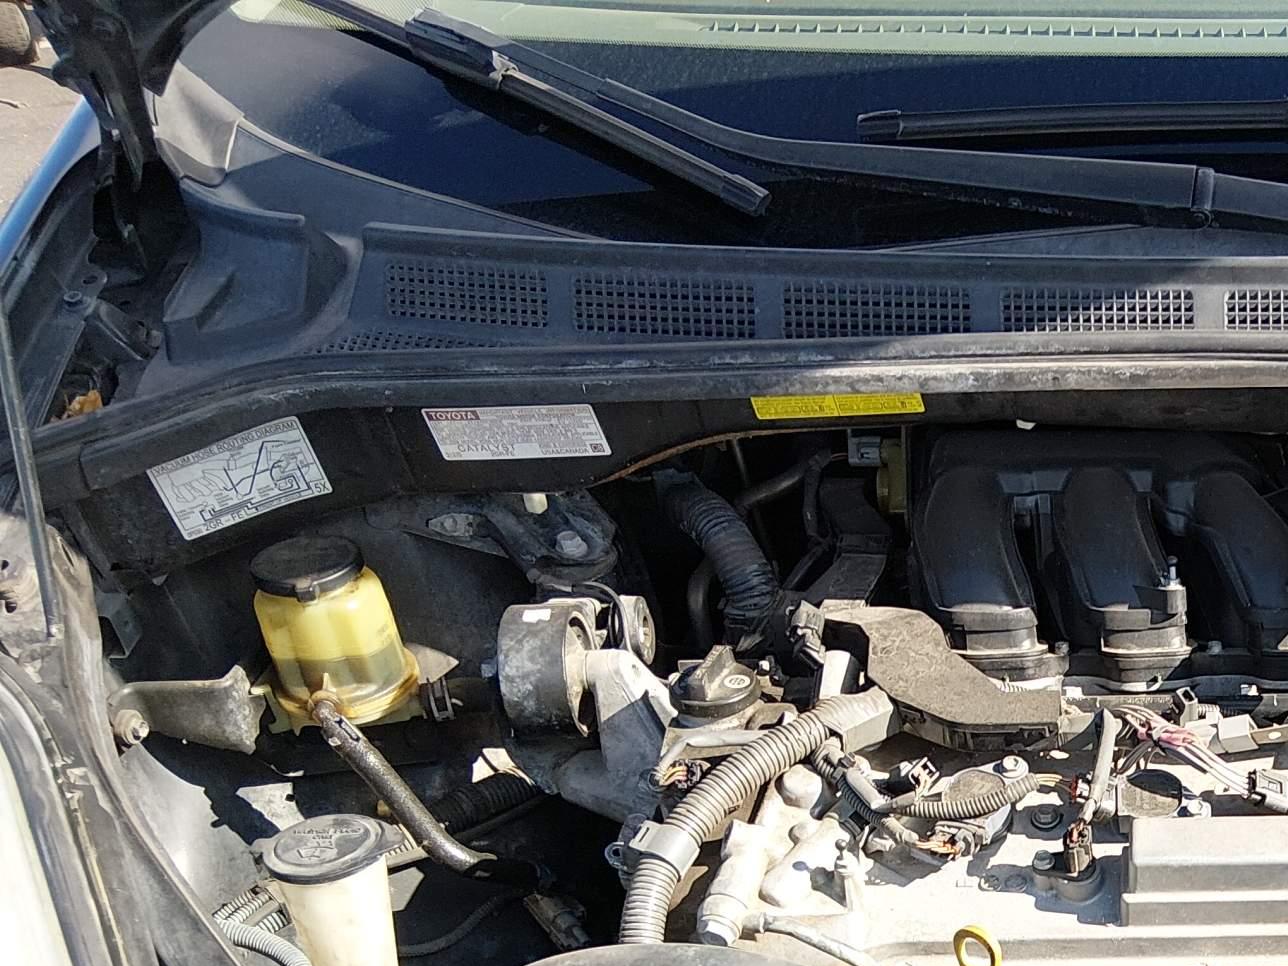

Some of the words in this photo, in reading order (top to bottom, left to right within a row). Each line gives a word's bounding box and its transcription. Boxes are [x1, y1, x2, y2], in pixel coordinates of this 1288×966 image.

[428, 411, 476, 420] TOYOTA
[153, 456, 191, 474] VACUUM
[192, 447, 217, 462] HOSE
[216, 434, 256, 453] ROUTING
[255, 421, 296, 440] DIAGRAM
[457, 443, 515, 453] CATALYST
[313, 482, 330, 494] 5X
